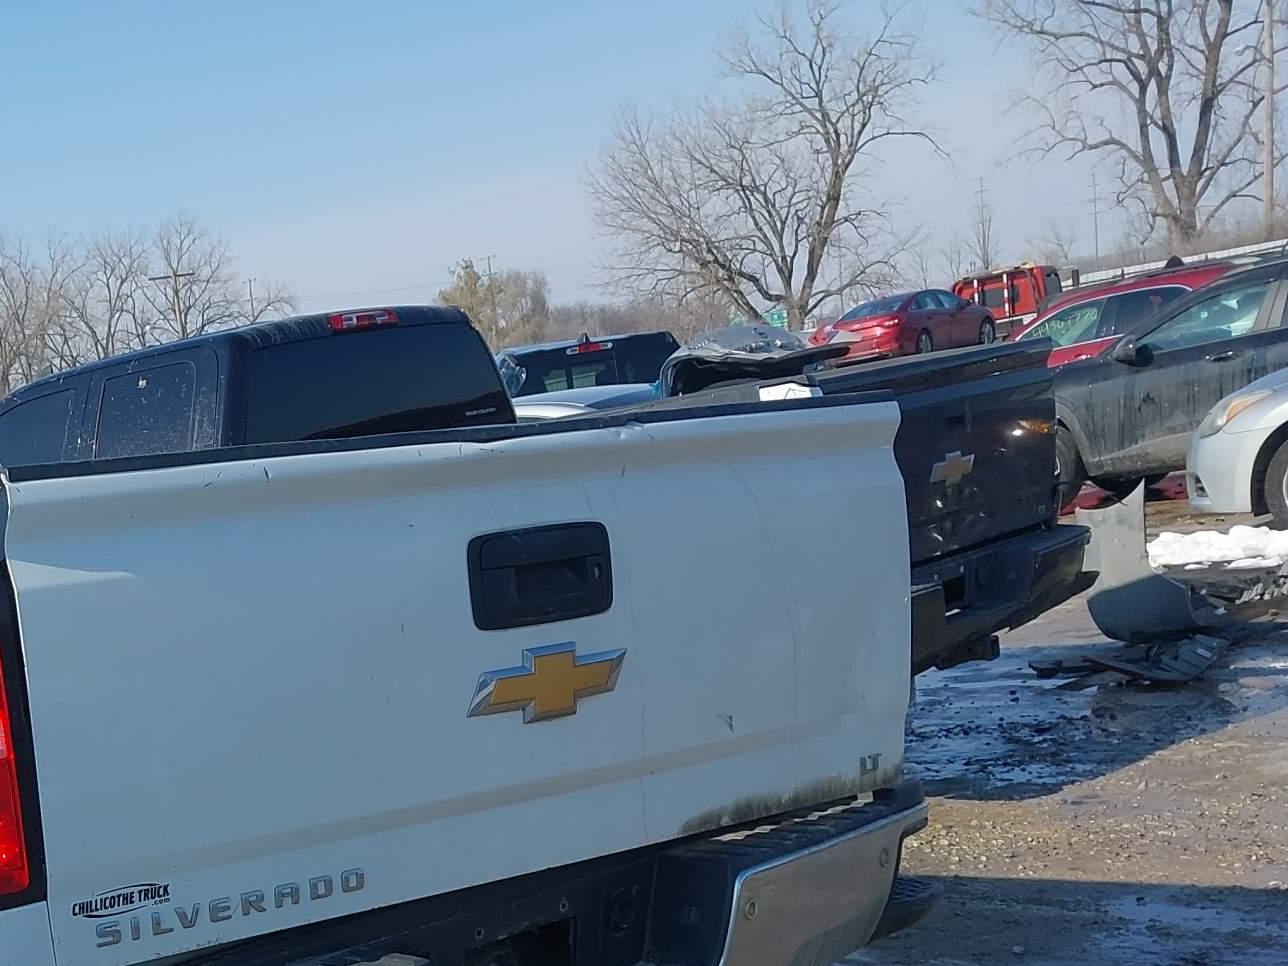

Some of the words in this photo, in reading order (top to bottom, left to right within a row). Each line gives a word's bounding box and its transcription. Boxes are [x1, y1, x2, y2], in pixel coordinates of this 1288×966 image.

[859, 753, 882, 776] LT
[71, 889, 136, 918] CHILLICOTHE
[137, 883, 170, 906] TRUCK
[95, 867, 366, 948] SILVERADO
[151, 897, 171, 907] .com
